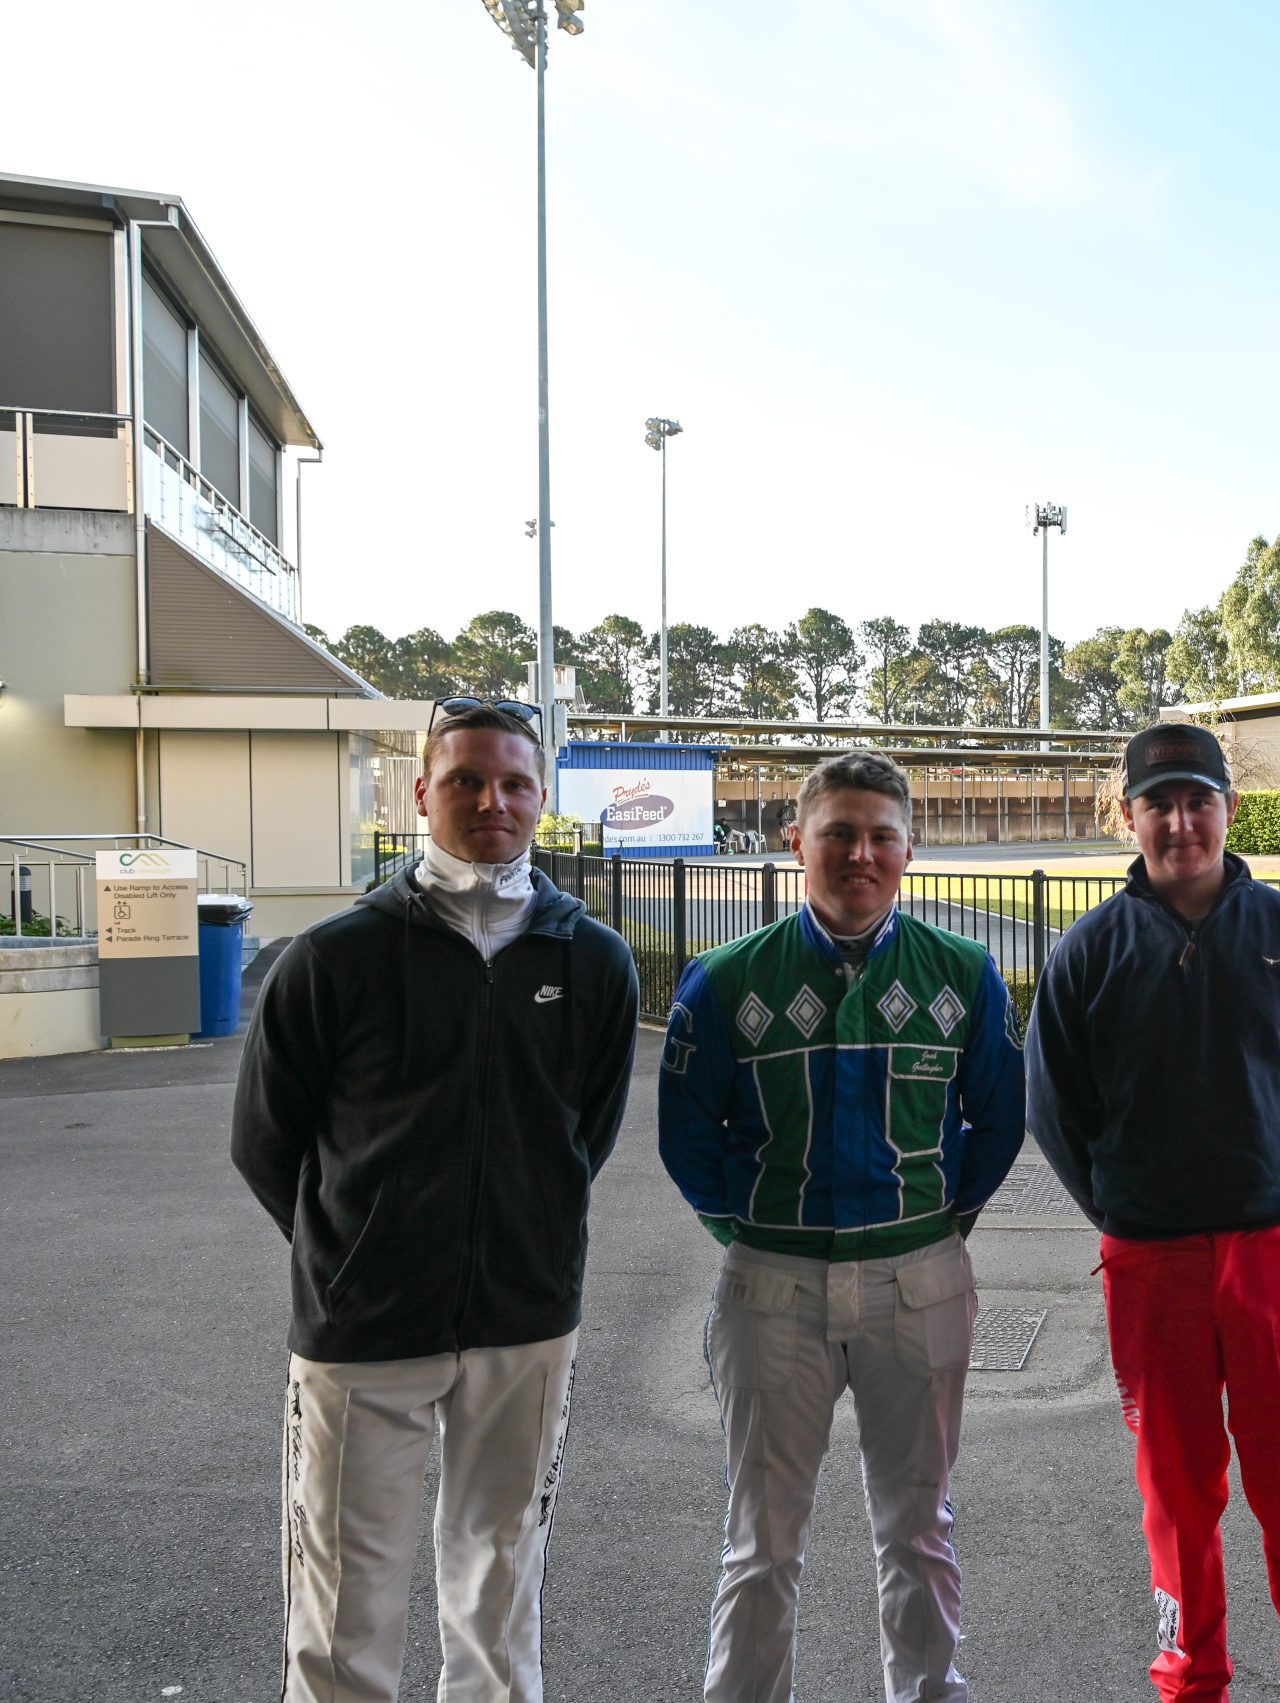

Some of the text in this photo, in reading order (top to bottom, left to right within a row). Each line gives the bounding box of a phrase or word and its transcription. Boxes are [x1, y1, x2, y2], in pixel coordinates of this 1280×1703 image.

[613, 778, 651, 801] Pryde's
[606, 805, 665, 821] EasiFeed
[604, 833, 704, 843] des.com.au 1300 732 267
[129, 884, 151, 893] Ramp
[146, 891, 158, 899] Lift
[159, 892, 176, 900] Only
[540, 985, 563, 997] NIKE
